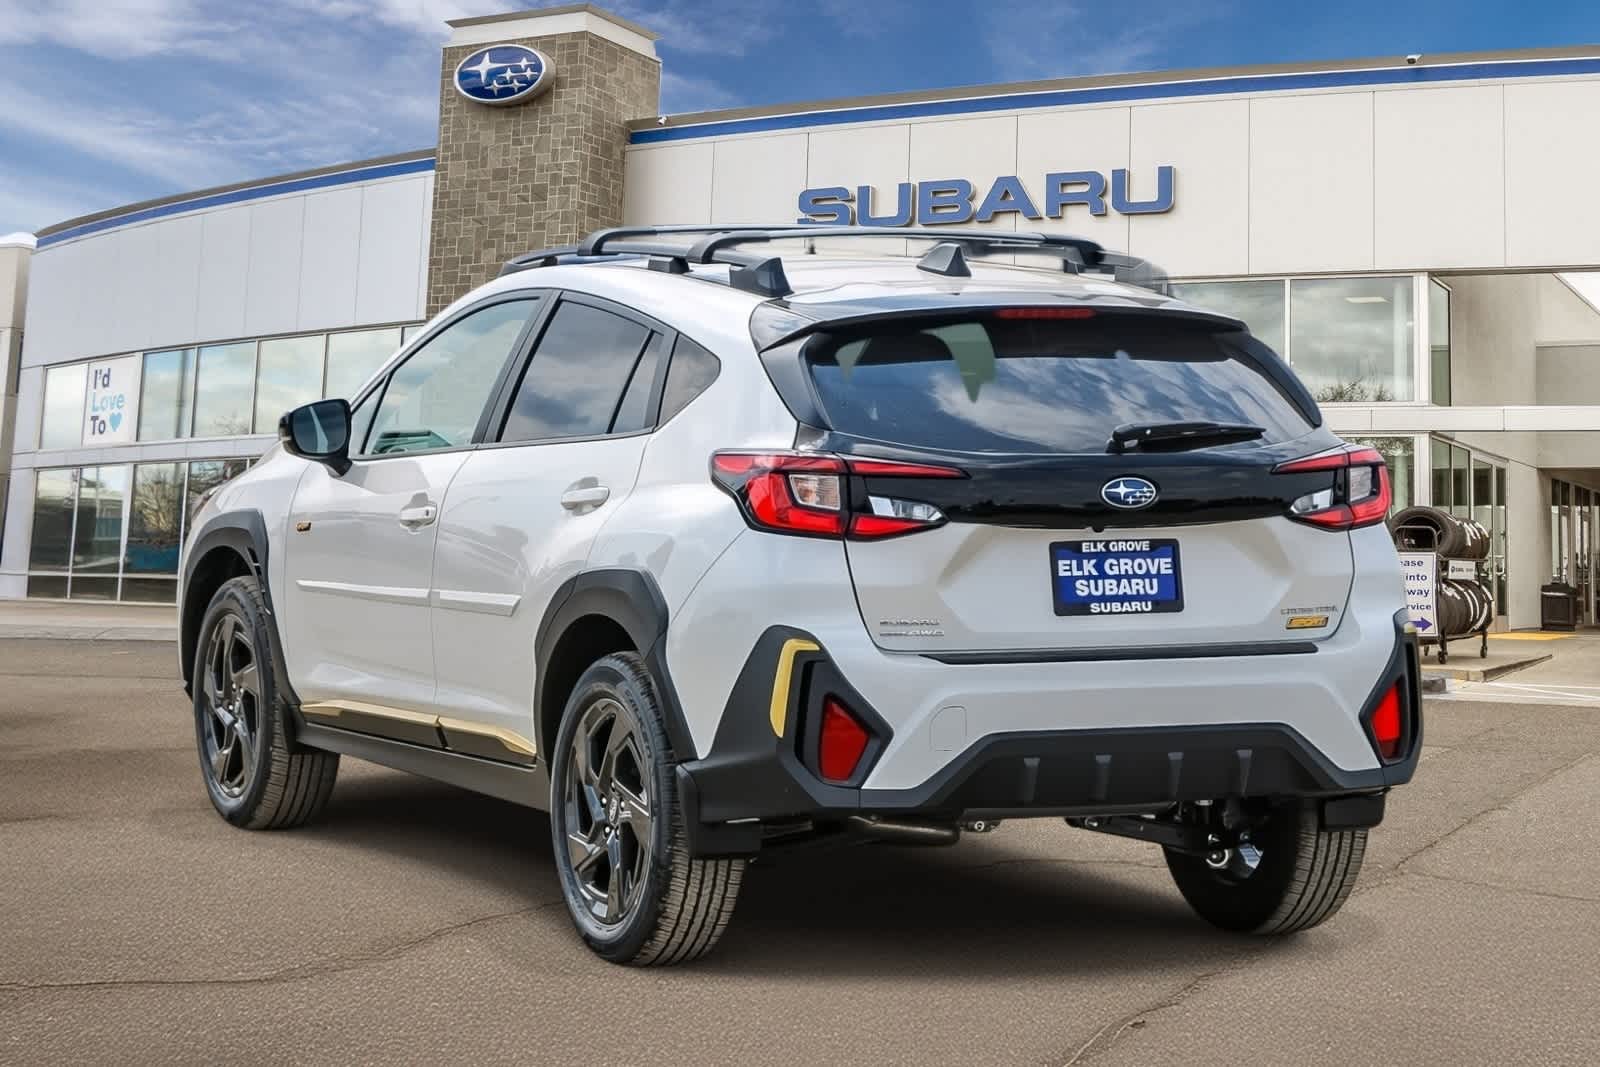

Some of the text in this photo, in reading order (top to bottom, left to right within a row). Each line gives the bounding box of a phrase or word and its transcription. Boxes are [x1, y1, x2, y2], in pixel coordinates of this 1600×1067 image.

[797, 165, 1176, 226] SUBARU
[93, 367, 112, 390] I'd
[91, 391, 126, 412] Love
[90, 415, 107, 436] To
[1081, 540, 1151, 553] ELK GROVE
[1057, 557, 1173, 577] ELK GROVE
[1405, 573, 1428, 581] into
[1074, 578, 1159, 597] SUBARU
[1406, 588, 1430, 597] way
[1090, 601, 1152, 613] SUBARU
